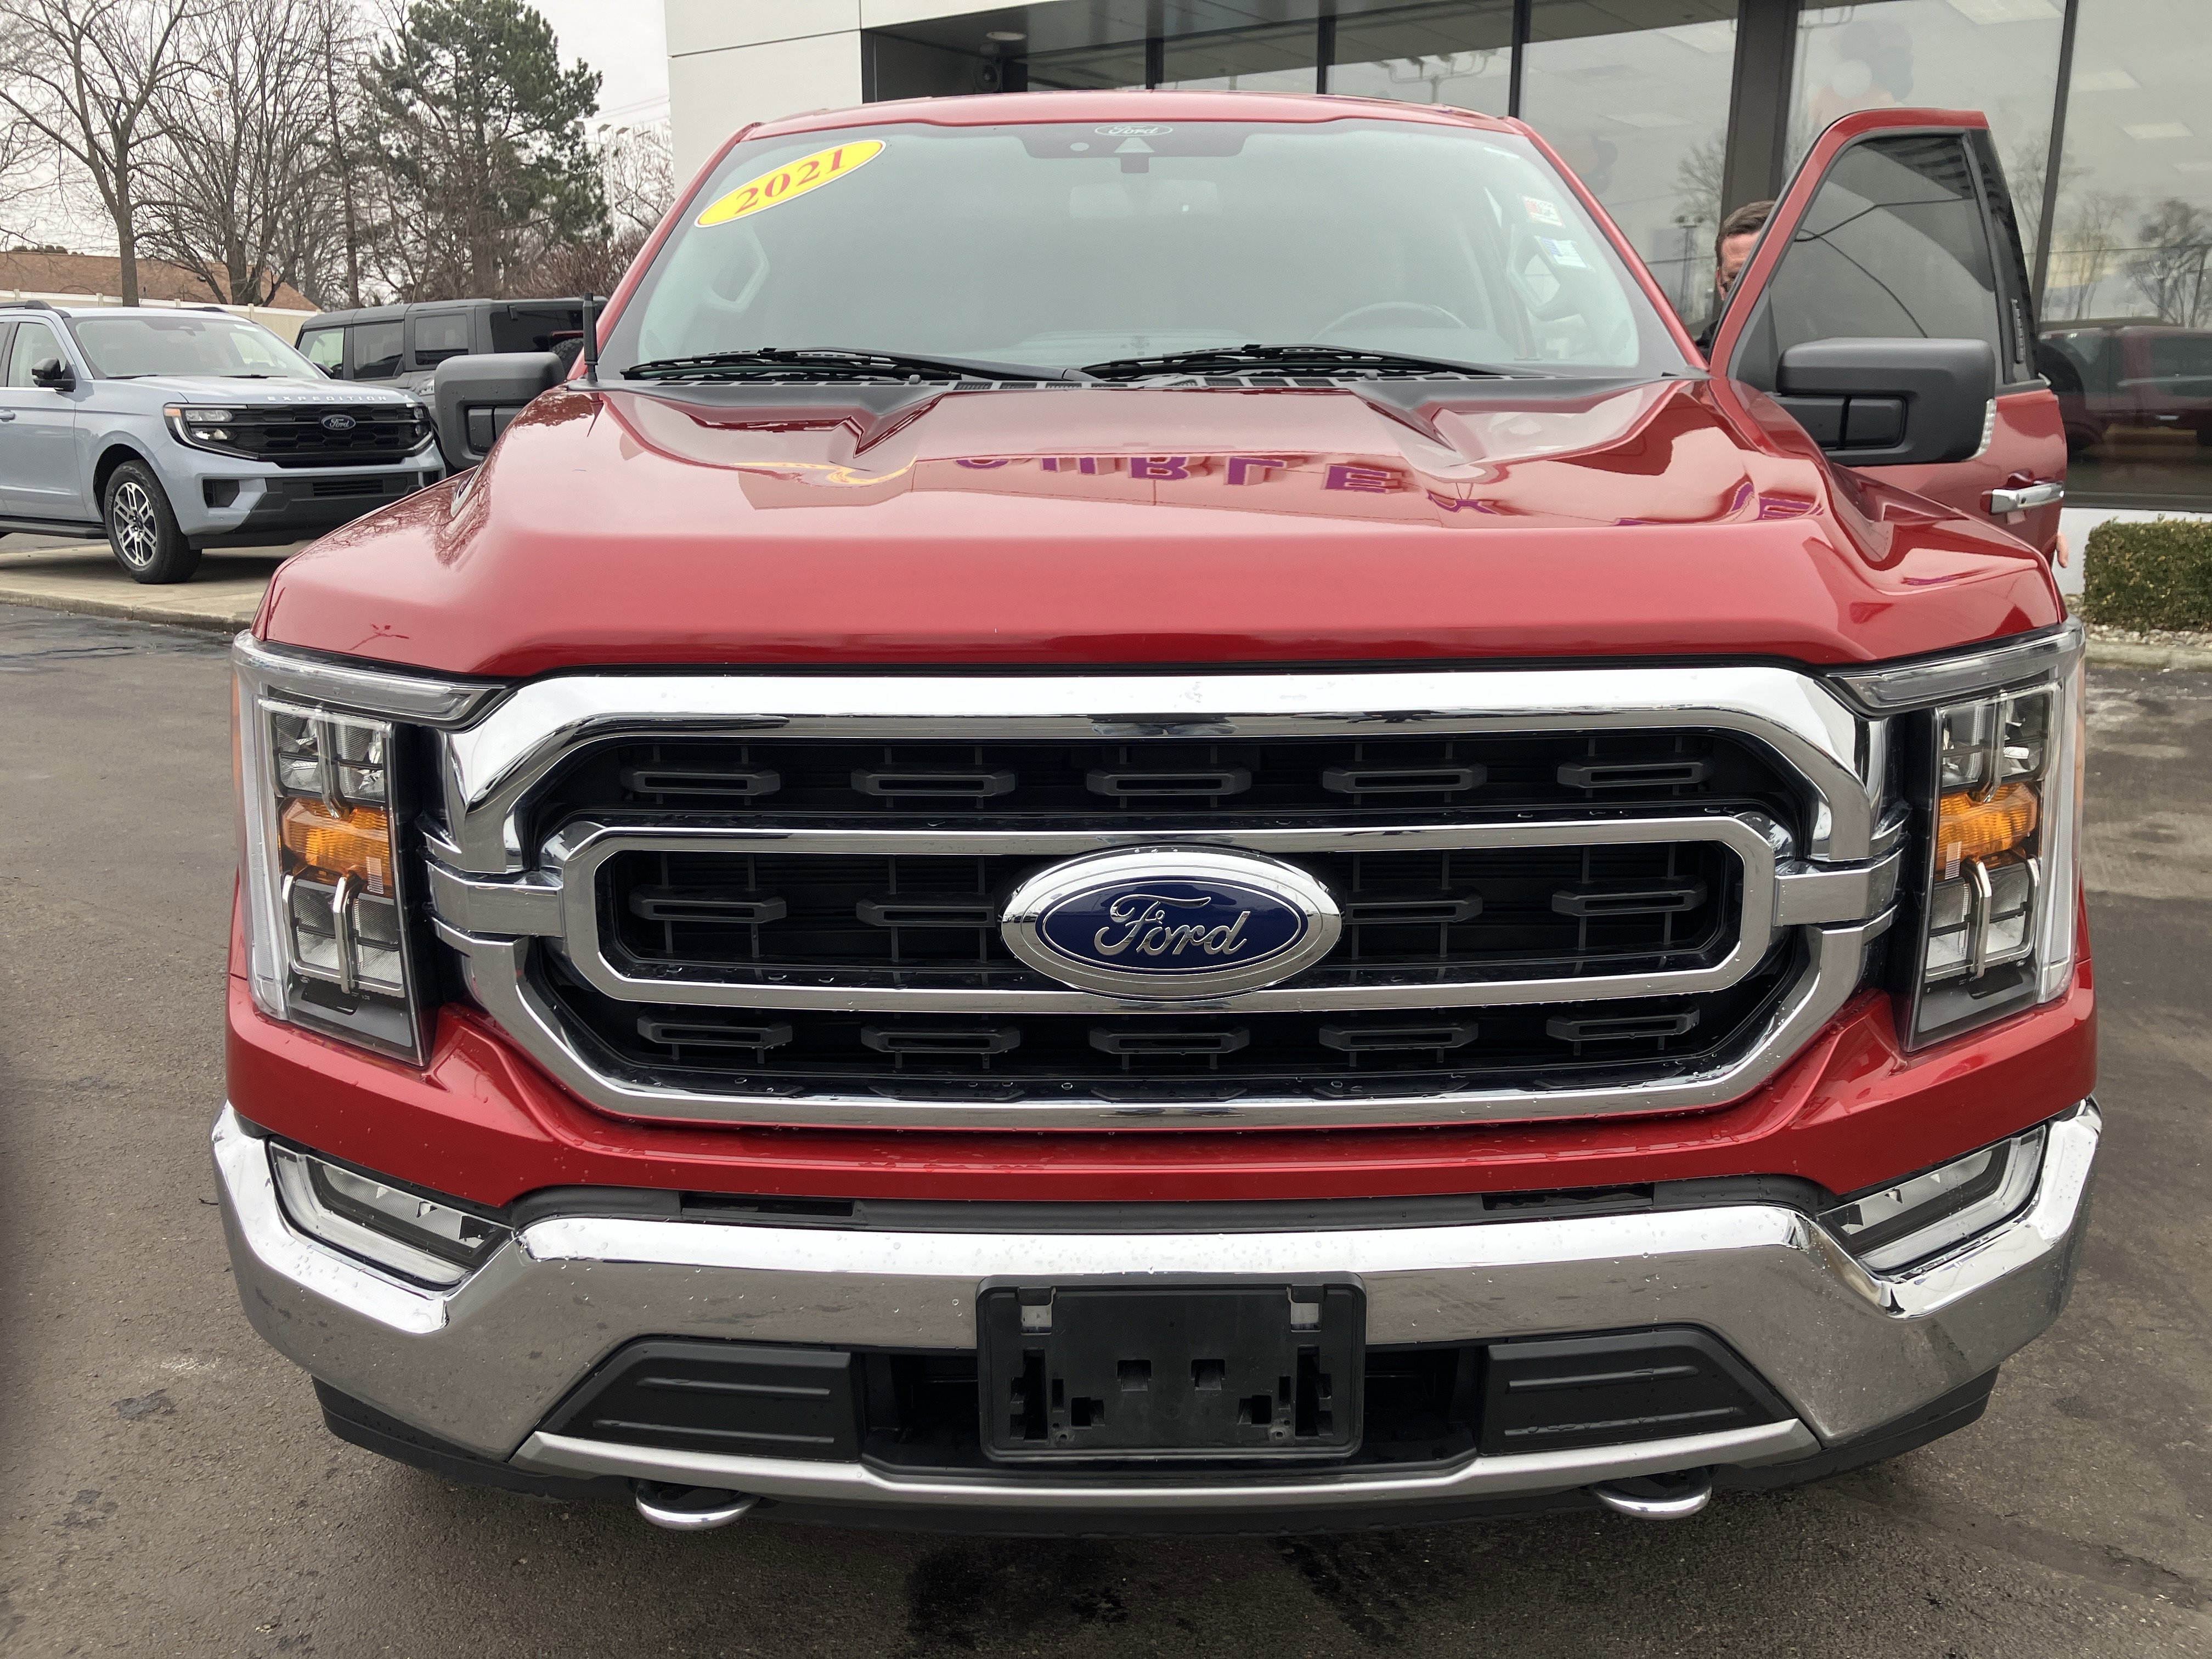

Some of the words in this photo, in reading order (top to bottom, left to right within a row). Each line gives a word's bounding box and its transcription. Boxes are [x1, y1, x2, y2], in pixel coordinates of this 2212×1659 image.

[1108, 125, 1159, 134] Ford
[734, 148, 845, 215] 2021
[329, 418, 349, 428] Ford
[1094, 894, 1251, 956] Ford
